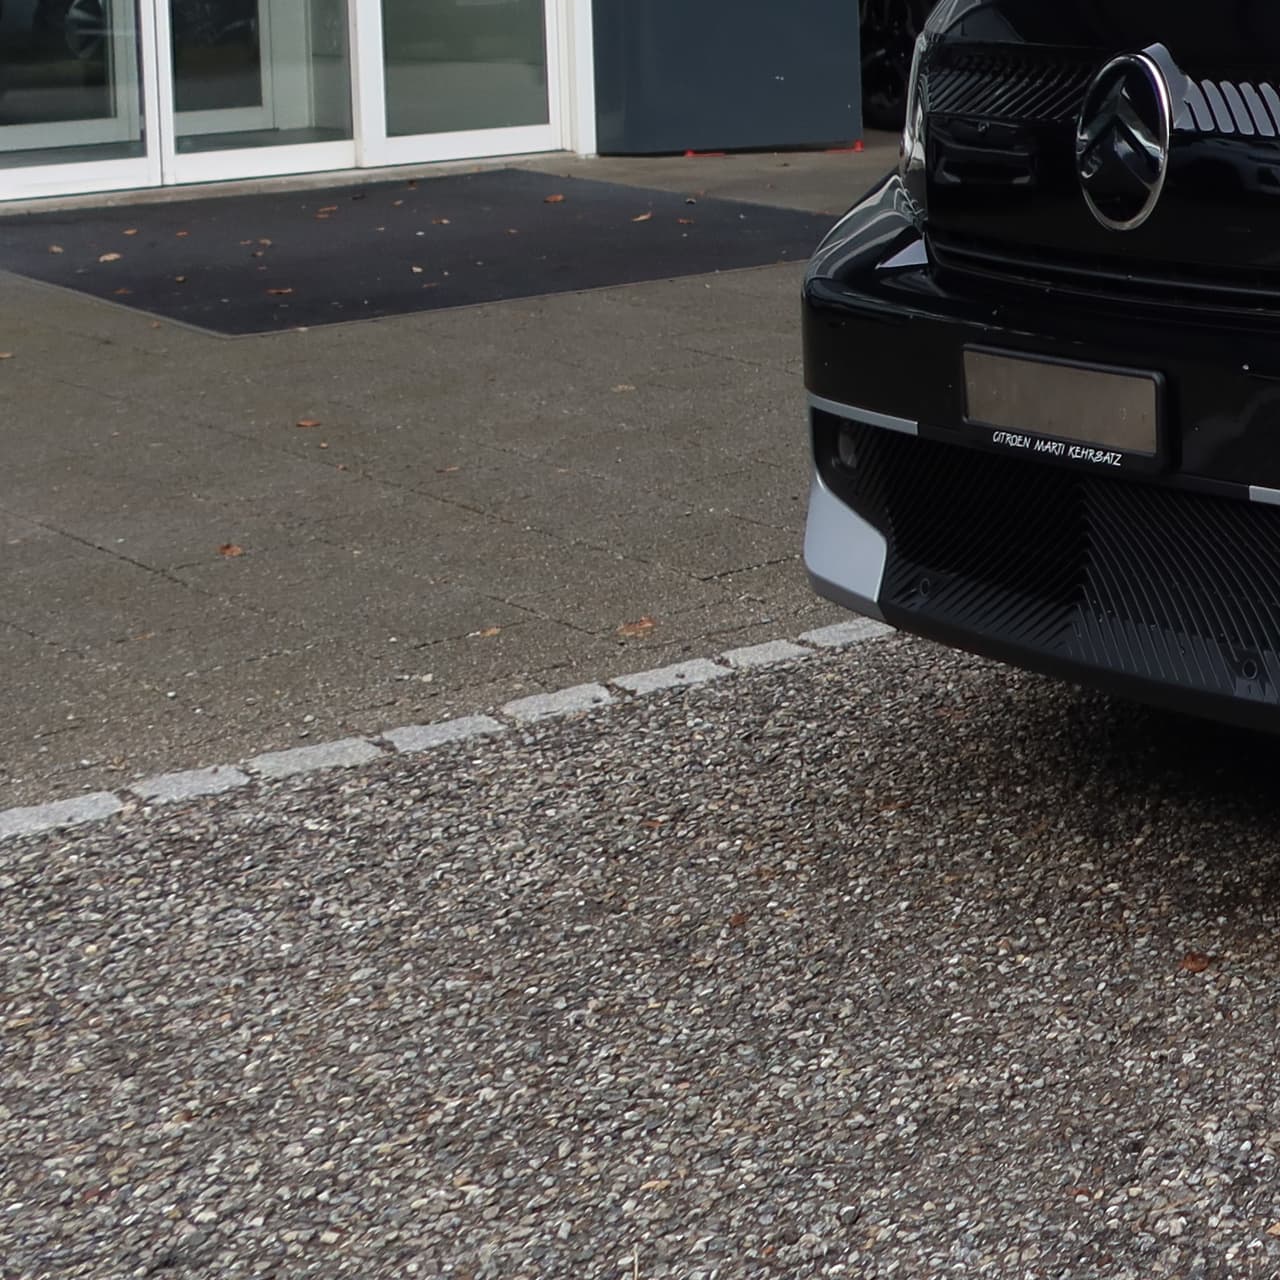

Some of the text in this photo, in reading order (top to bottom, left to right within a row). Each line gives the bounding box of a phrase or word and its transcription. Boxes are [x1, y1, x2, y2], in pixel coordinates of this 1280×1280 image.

[992, 431, 1123, 466] CITROEN MARTI KEHRSATZ
